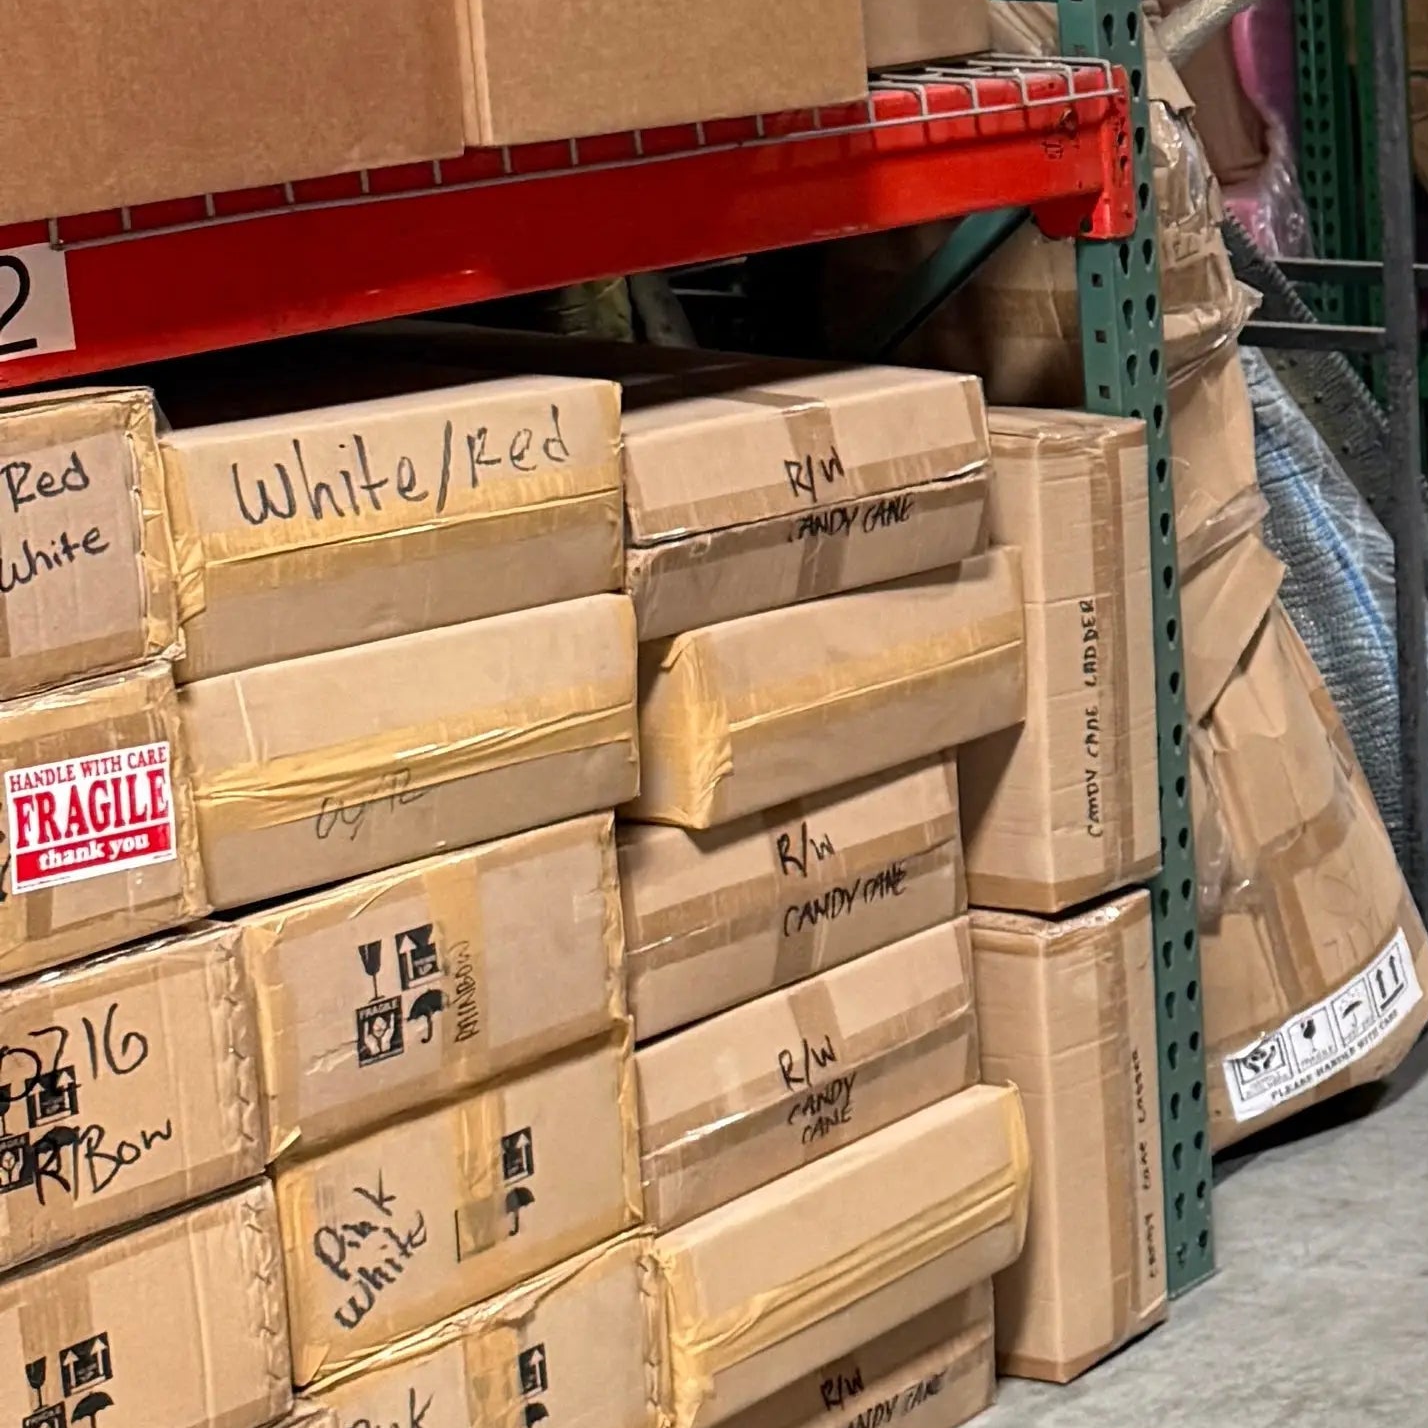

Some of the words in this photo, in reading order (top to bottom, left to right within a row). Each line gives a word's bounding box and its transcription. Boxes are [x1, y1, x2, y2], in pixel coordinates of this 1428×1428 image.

[0, 255, 38, 355] 2
[0, 451, 90, 513] Red
[1079, 600, 1099, 687] LADDER
[9, 764, 77, 793] HANDLE
[80, 755, 122, 778] WITH
[127, 746, 167, 770] CARE
[12, 767, 169, 850] FRAGILE
[38, 840, 106, 871] thank
[109, 833, 150, 861] you
